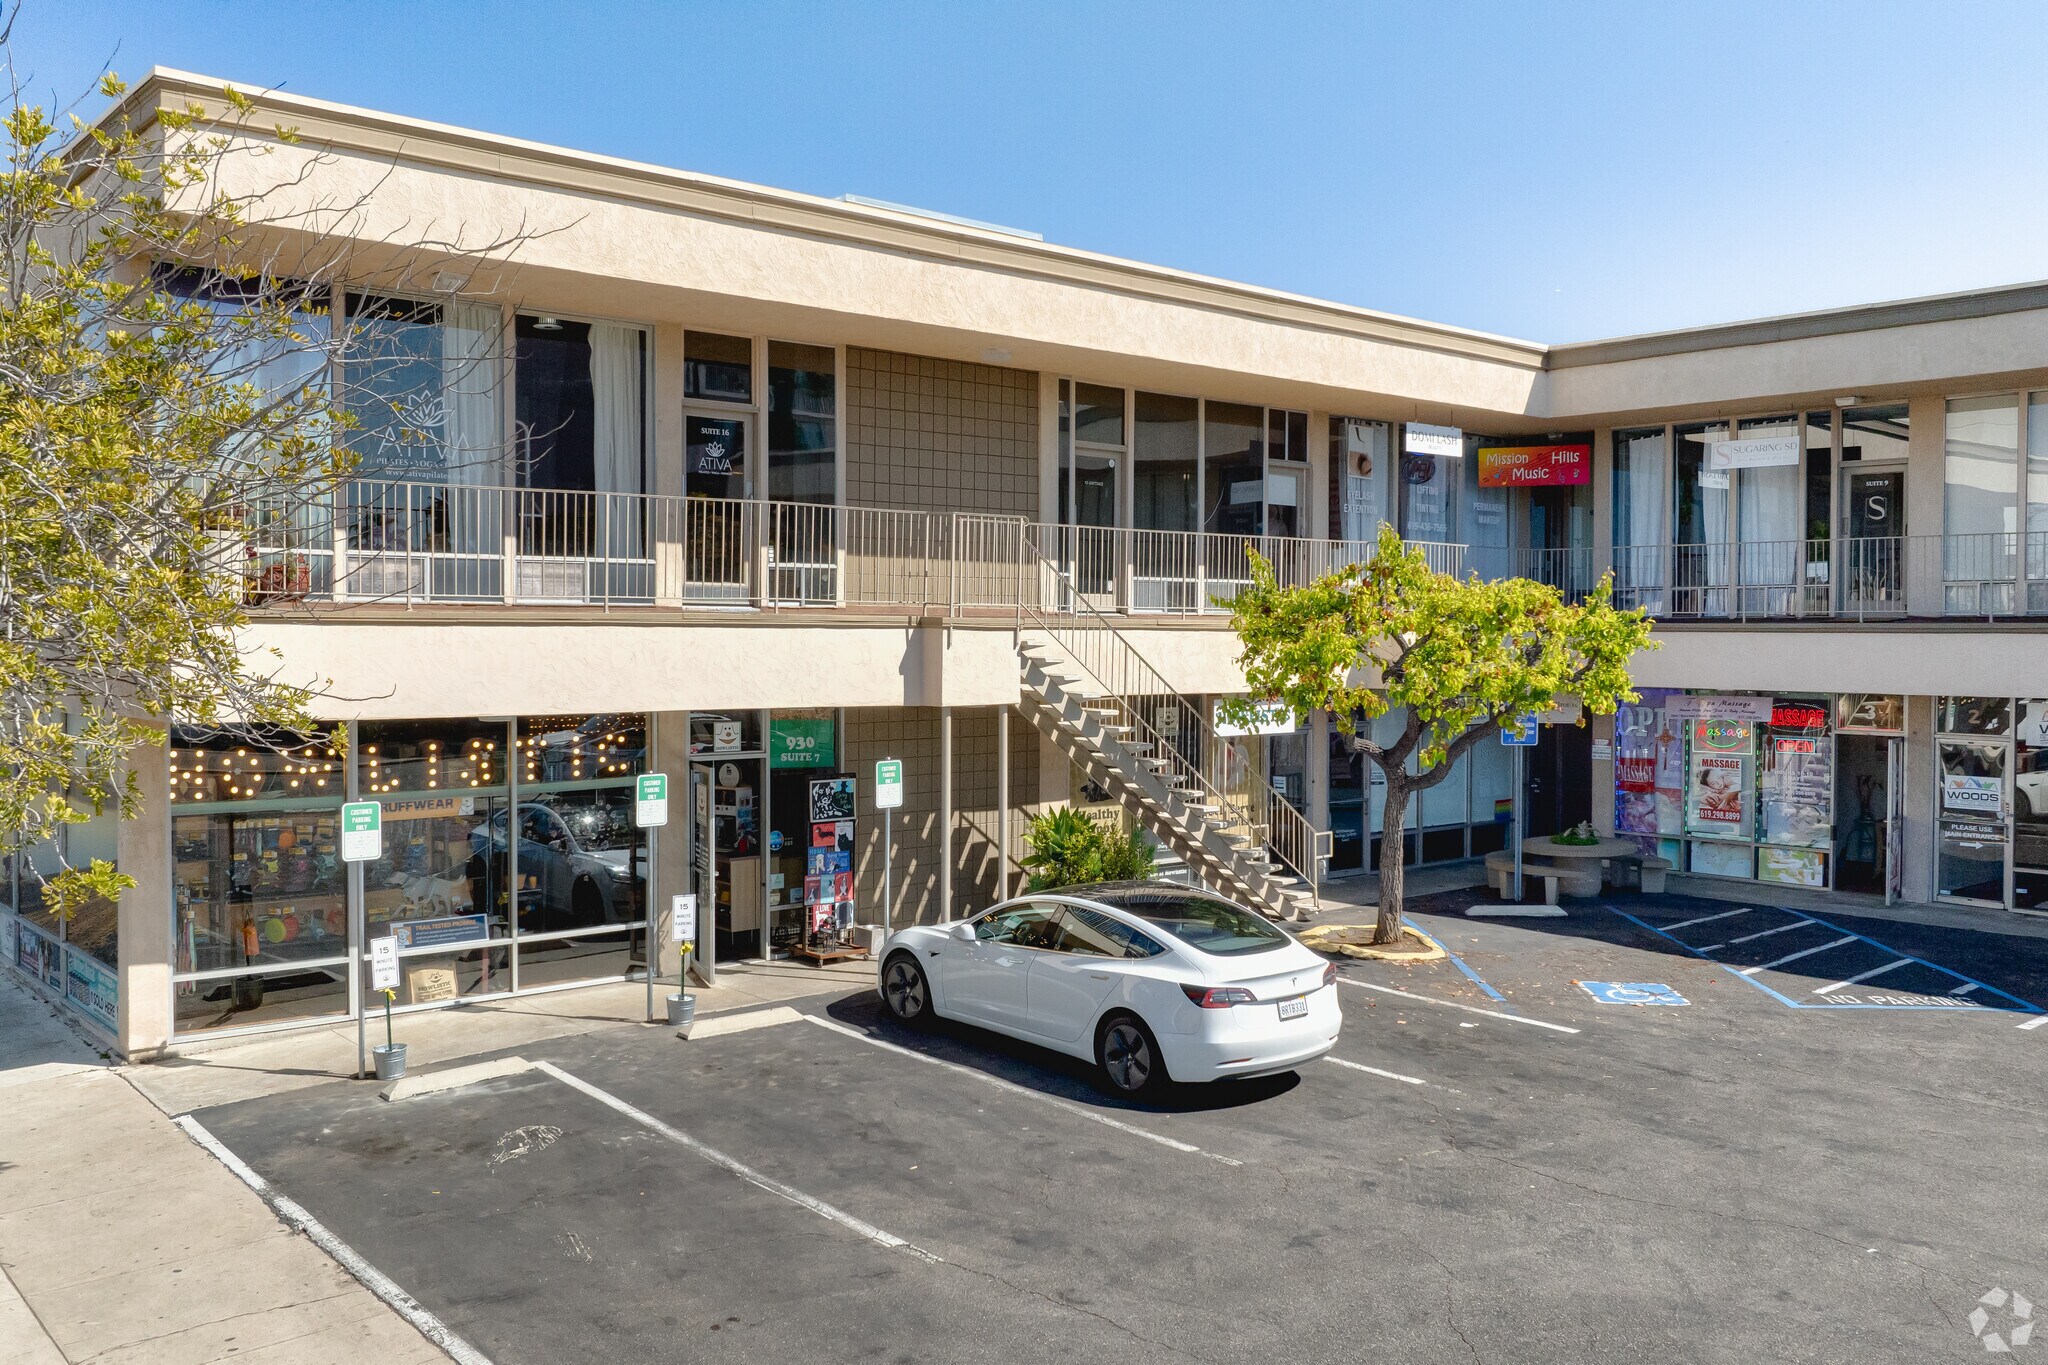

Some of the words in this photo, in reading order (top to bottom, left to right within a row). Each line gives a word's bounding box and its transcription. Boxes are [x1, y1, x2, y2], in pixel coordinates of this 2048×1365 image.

[701, 427, 720, 436] SUITE
[378, 426, 476, 460] ATIVA
[1411, 430, 1435, 444] DOMI
[1436, 433, 1457, 446] LASH
[1733, 443, 1783, 454] SUGARING
[1784, 441, 1798, 451] SD
[376, 457, 408, 467] PILATES
[698, 456, 733, 471] ATIVA
[1486, 453, 1529, 467] Mission
[1551, 450, 1580, 465] Hills
[1512, 467, 1550, 481] Music
[1884, 479, 1889, 487] 9
[1347, 489, 1375, 501] EYELASH
[1416, 486, 1439, 496] LIFTING
[1343, 503, 1378, 515] EXTENTION
[1416, 503, 1439, 514] TINTING
[1864, 705, 1876, 720] 3
[1968, 709, 1981, 725] 2
[1695, 723, 1751, 740] Massage
[785, 736, 815, 750] 930
[1777, 740, 1813, 752] OPEN
[780, 752, 812, 762] SUITE
[813, 753, 821, 763] 7
[1701, 758, 1740, 770] MASSAGE
[1620, 764, 1655, 783] MASSAGE
[1946, 790, 1999, 802] WOODS
[350, 808, 373, 816] CUSTOMER
[380, 798, 453, 814] RUFFWEAR
[351, 816, 372, 824] PARKING
[1699, 809, 1741, 821] 619.298.8899
[1951, 823, 1978, 832] PLEASE
[1944, 830, 1962, 838] MAIN
[1962, 832, 2001, 841] ENTRANCE
[819, 905, 830, 913] LOVE
[431, 922, 451, 930] TESTED
[379, 946, 390, 955] 15
[376, 957, 393, 965] MINUTE
[375, 965, 396, 973] PARKING
[417, 980, 452, 992] HOWLISTIC
[1820, 994, 1863, 1005] NO
[1867, 995, 1983, 1007] PARKING
